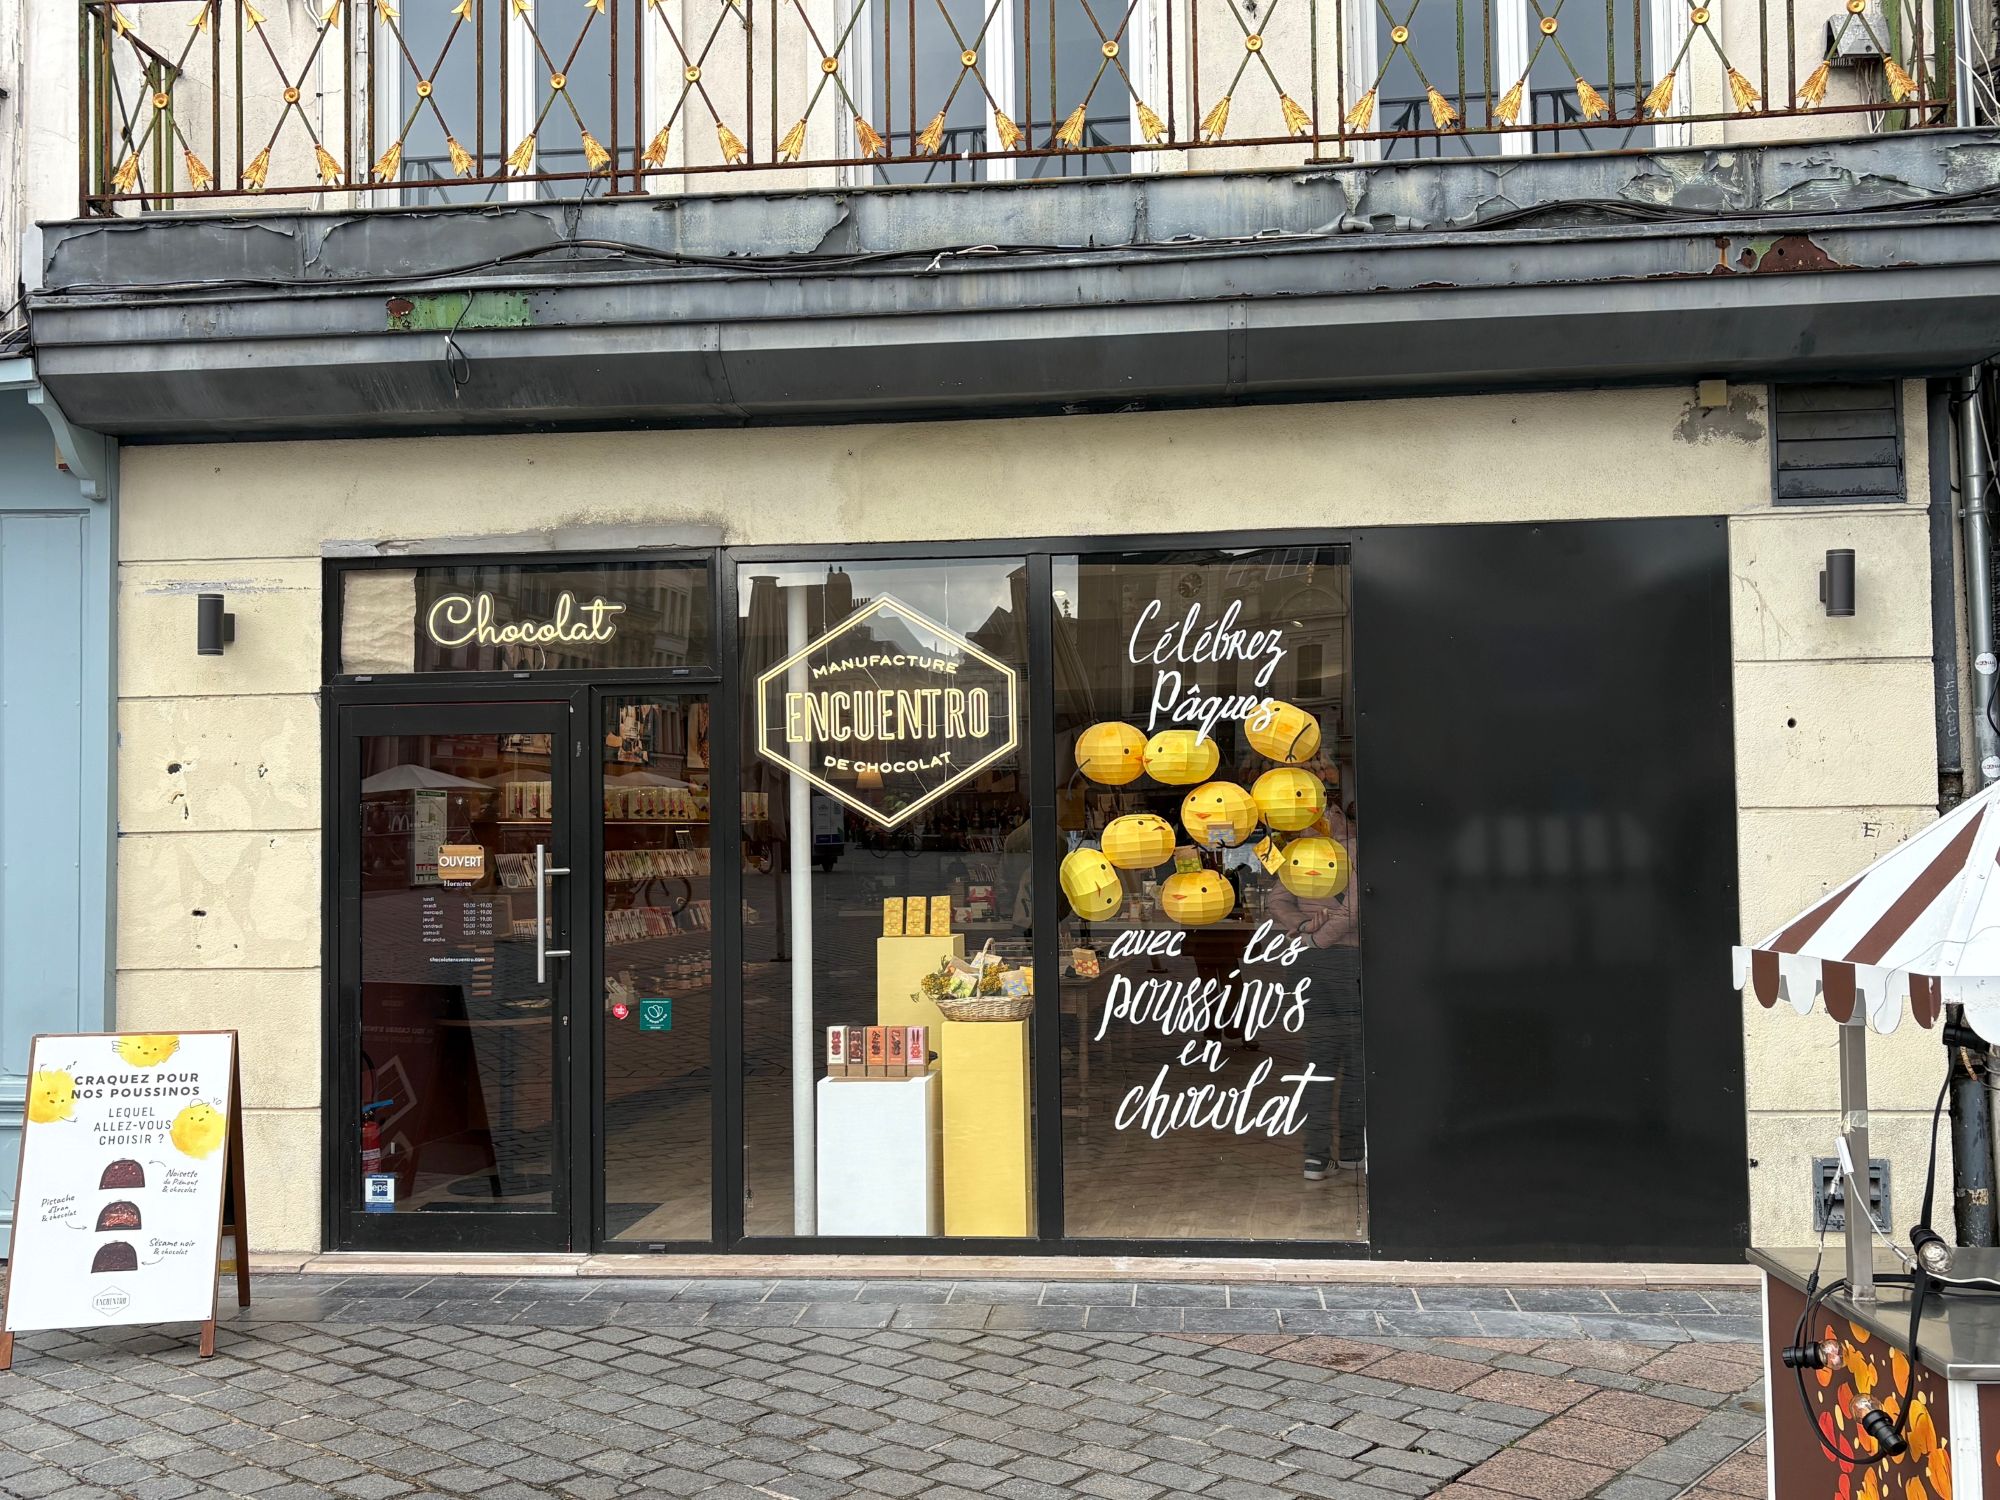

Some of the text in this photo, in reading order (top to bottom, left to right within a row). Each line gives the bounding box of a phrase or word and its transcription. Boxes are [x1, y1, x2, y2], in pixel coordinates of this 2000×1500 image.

[429, 593, 627, 645] Chocolat
[1128, 599, 1287, 688] Célébrez
[813, 654, 959, 679] MANUFACTURE
[785, 687, 989, 743] ENCUENTRO
[1147, 669, 1279, 747] Pâques
[824, 751, 952, 774] DE CHOCOLAT
[439, 856, 482, 867] OUVERT
[443, 880, 472, 888] Horaires
[1108, 918, 1310, 966] avec les
[1094, 969, 1313, 1042] poussinos
[1176, 1039, 1230, 1072] en
[74, 1073, 199, 1086] CRAQUEZ POUR
[71, 1086, 200, 1099] NOS POUSSINOS
[1114, 1056, 1336, 1139] chocolat
[108, 1107, 155, 1118] LEQUEL
[94, 1120, 172, 1132] ALLEZ-VOUS
[99, 1133, 165, 1145] CHOISIR ?
[165, 1168, 198, 1178] Noisette
[41, 1194, 75, 1207] Pistache
[149, 1238, 178, 1247] Sésame
